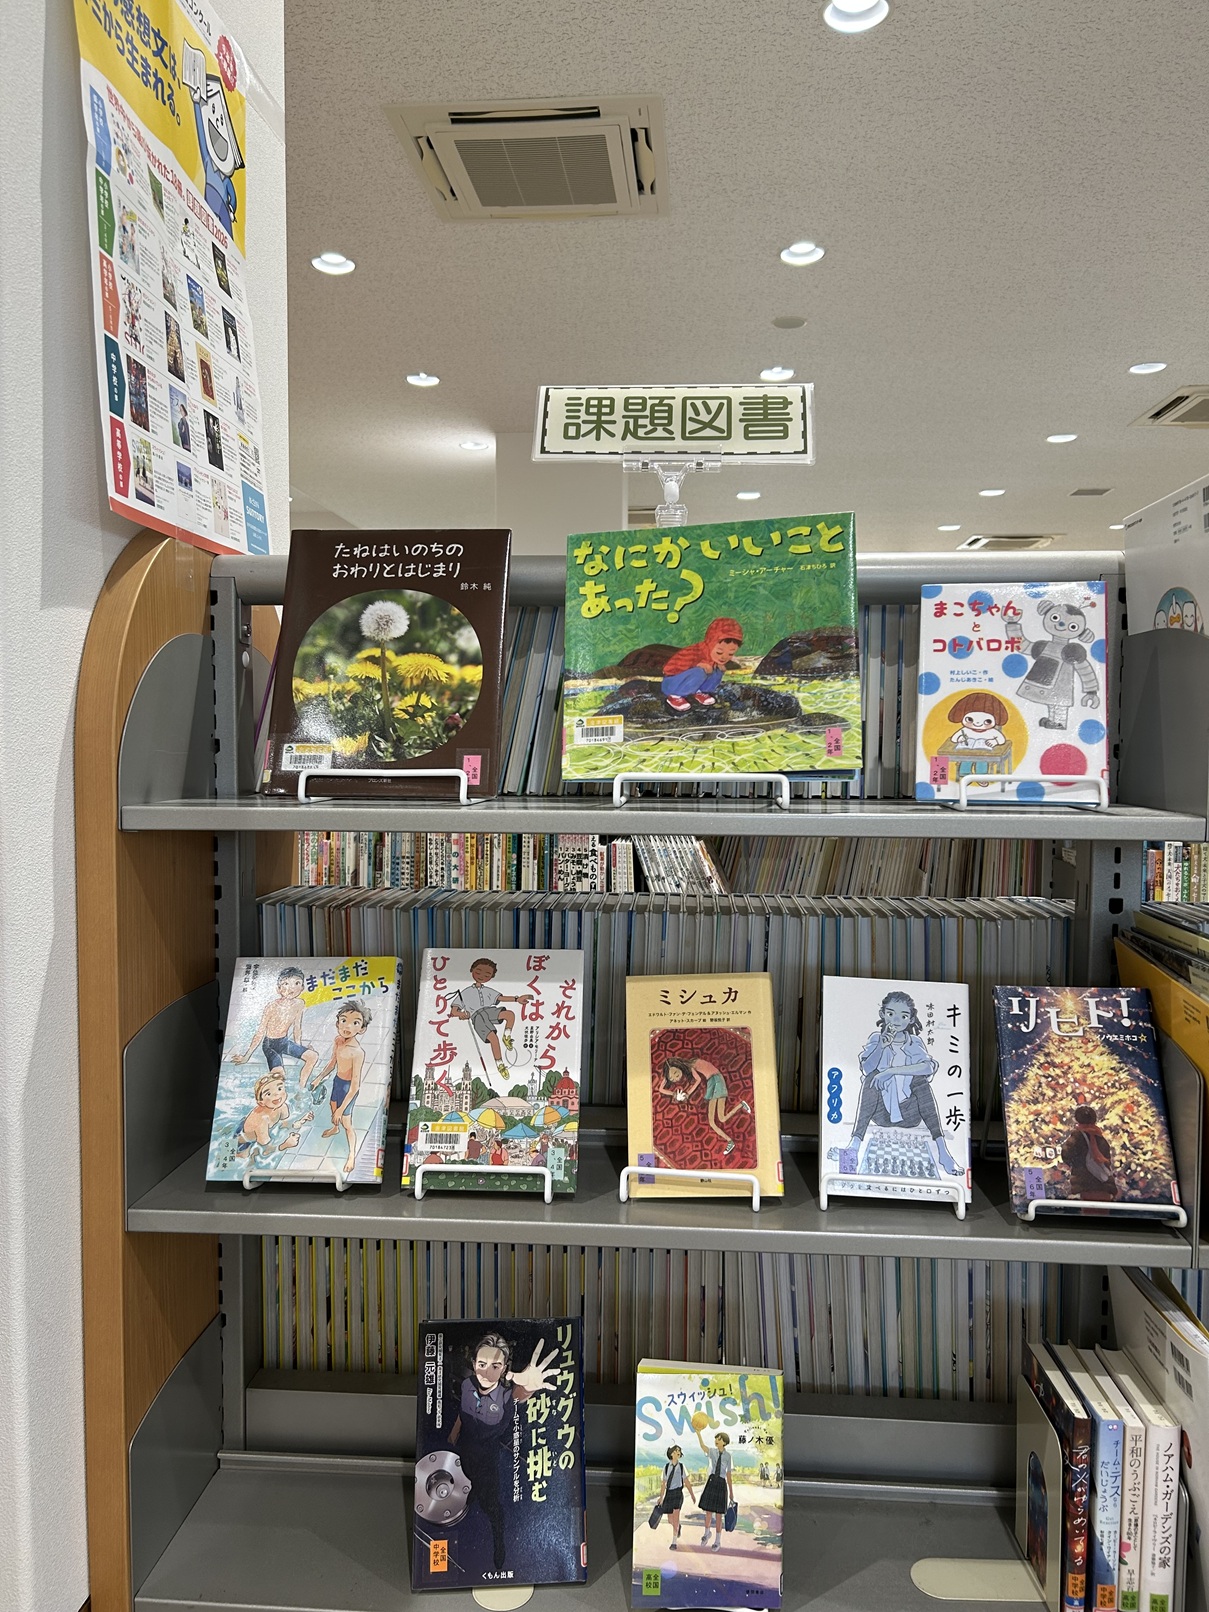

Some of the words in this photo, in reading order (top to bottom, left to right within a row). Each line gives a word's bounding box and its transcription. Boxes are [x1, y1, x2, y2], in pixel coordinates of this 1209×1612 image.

[112, 0, 181, 90] 感想文は、
[563, 394, 793, 441] 課題図書
[334, 542, 464, 559] たねはいのちの
[573, 521, 844, 577] なにかいいこと
[332, 562, 462, 579] おわりとはじまり
[729, 565, 794, 577] ミーシャ・アーチャー
[578, 568, 704, 624] あった?
[933, 600, 1022, 618] まこちゃん
[971, 622, 981, 633] と
[933, 637, 1022, 653] コトバロボ
[833, 737, 841, 752] 全国
[471, 766, 479, 780] 全国
[940, 766, 947, 780] 全国
[305, 959, 369, 992] まだまだ
[332, 976, 390, 1001] ここから
[521, 954, 550, 1022] ぼくは
[659, 987, 739, 1006] ミシュカ
[540, 978, 577, 1070] それから
[925, 1002, 935, 1046] 味田村太郎
[1007, 996, 1131, 1037] リヒト!
[1096, 1032, 1138, 1042] イノウエミホコ
[945, 1003, 966, 1131] キミの一歩
[831, 1071, 839, 1120] アフリカ
[229, 1148, 235, 1161] 全国
[556, 1156, 562, 1171] 全国
[1035, 1175, 1043, 1191] 全国
[556, 1323, 577, 1470] リュウグウの
[667, 1384, 734, 1407] スウィッシュ!
[636, 1374, 783, 1441] Swish!
[527, 1392, 553, 1502] 砂に挑む
[738, 1435, 775, 1446] 藤ノ木優
[1099, 1461, 1109, 1512] だいじょうぶ
[1128, 1434, 1143, 1516] 平和のうぶごえ
[1158, 1442, 1174, 1568] ノアハム・ガーデンズの家
[440, 1547, 447, 1562] 全国
[482, 1571, 514, 1579] くもん出版
[652, 1574, 660, 1589] 全国
